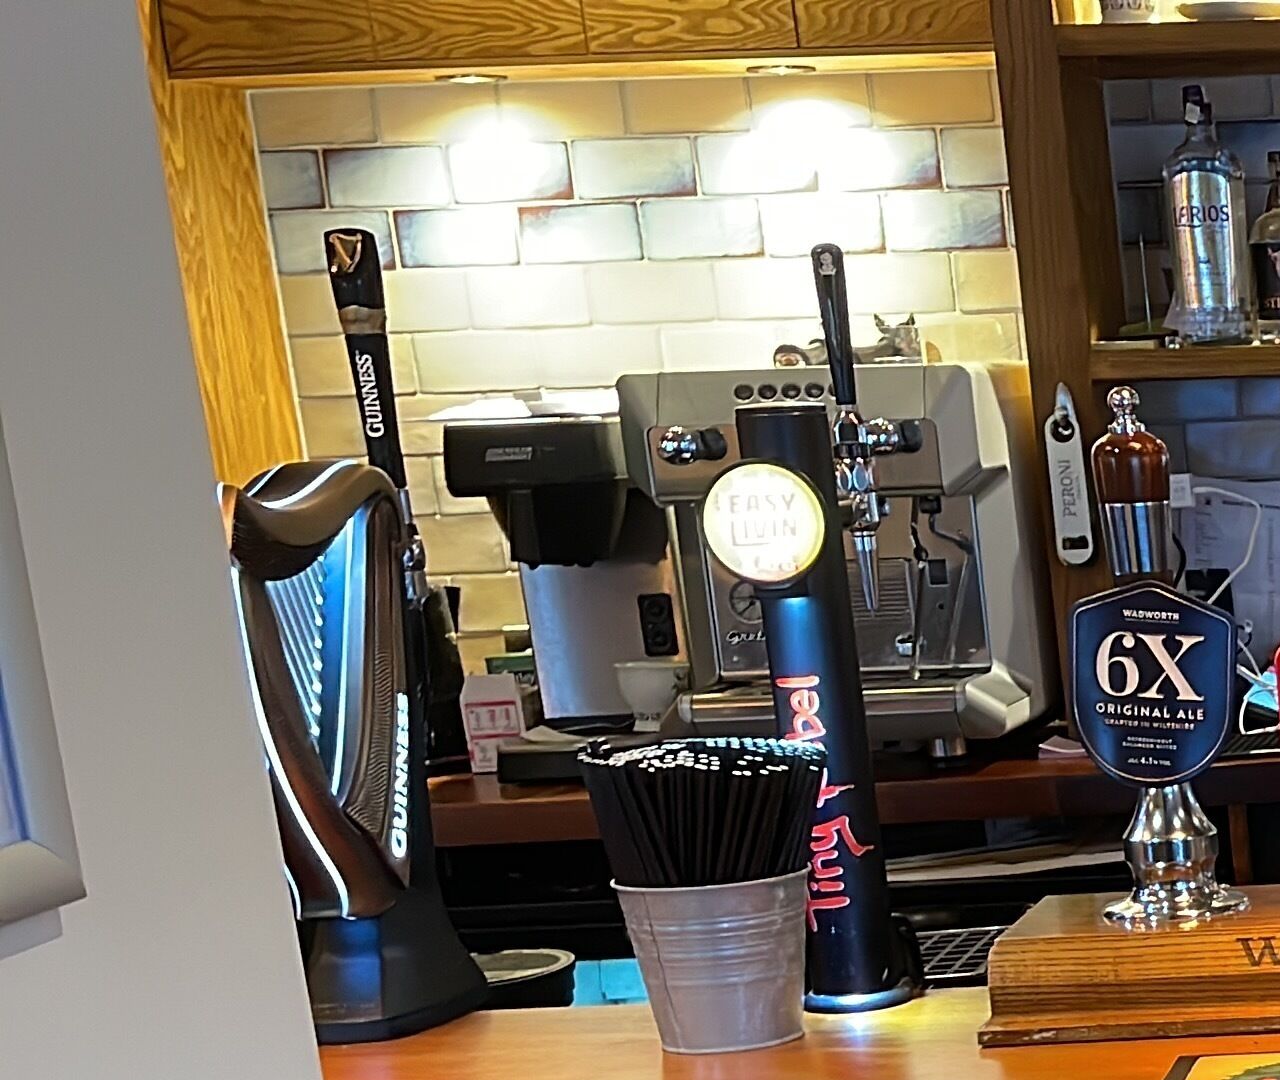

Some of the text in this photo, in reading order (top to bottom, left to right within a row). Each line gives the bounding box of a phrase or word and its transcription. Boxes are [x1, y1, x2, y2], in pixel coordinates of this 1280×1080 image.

[355, 353, 385, 438] GUINNESS
[729, 493, 795, 514] EASY
[1057, 459, 1078, 517] PERONI
[731, 518, 797, 547] LIVIN
[1122, 609, 1180, 621] WADWORTH
[1096, 631, 1205, 701] 6X
[1096, 703, 1204, 721] ORIGINAL ALE
[391, 692, 409, 858] GUINNESS
[806, 815, 874, 932] Tiny
